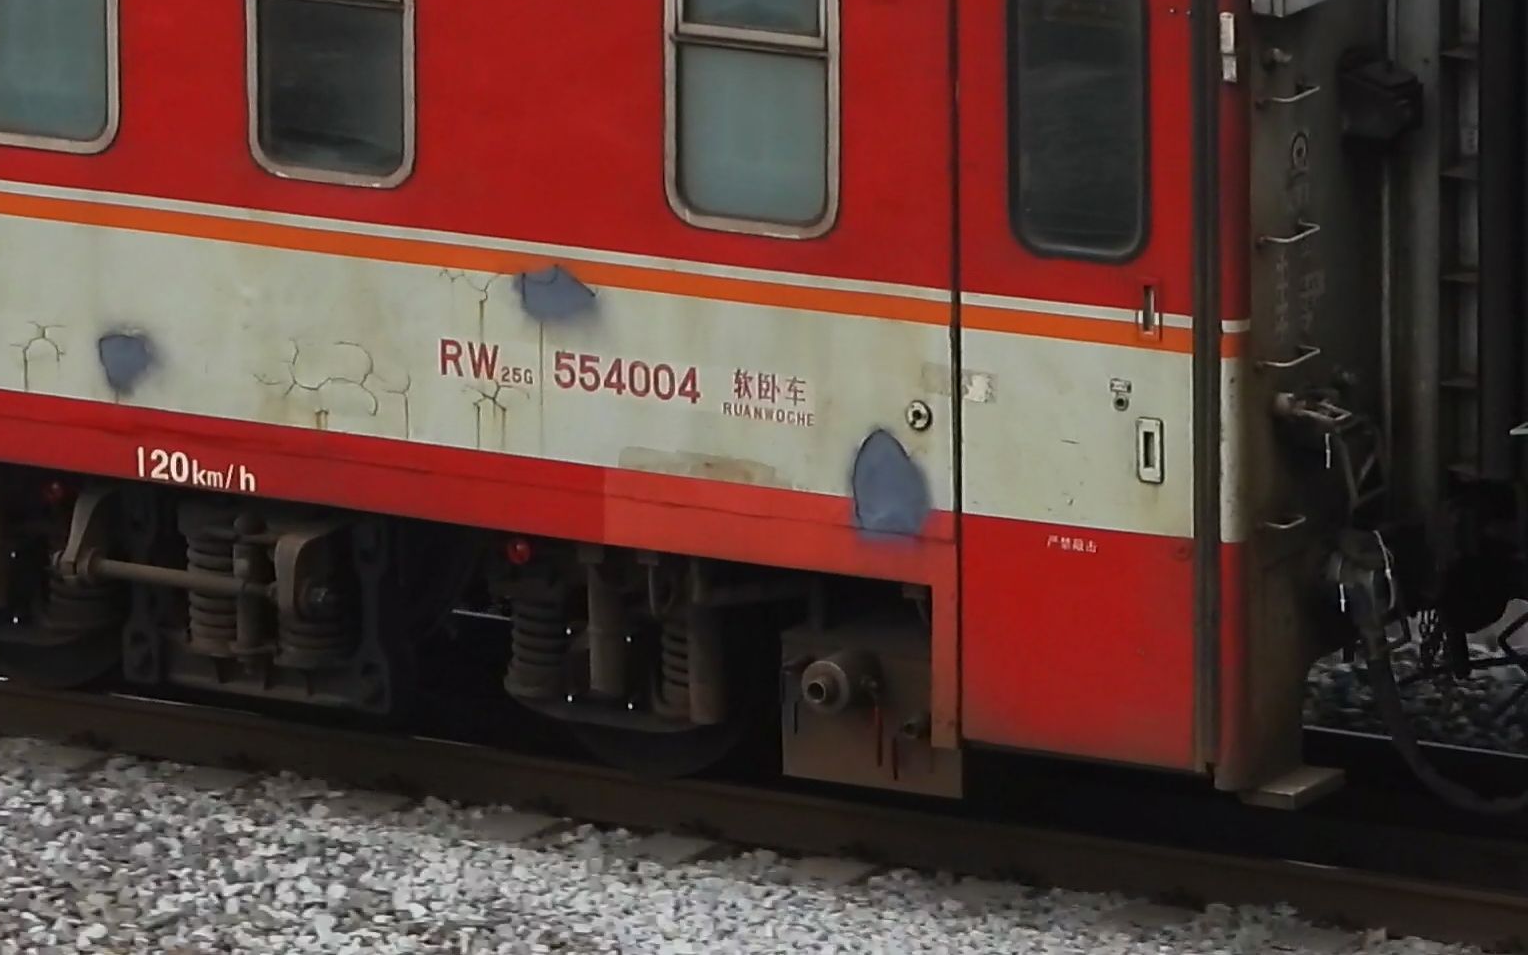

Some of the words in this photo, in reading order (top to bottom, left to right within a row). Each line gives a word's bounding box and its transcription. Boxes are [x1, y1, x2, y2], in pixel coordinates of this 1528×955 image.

[553, 350, 702, 405] 554004
[733, 368, 807, 406] 软卧车
[722, 401, 815, 428] RUANWOCHE
